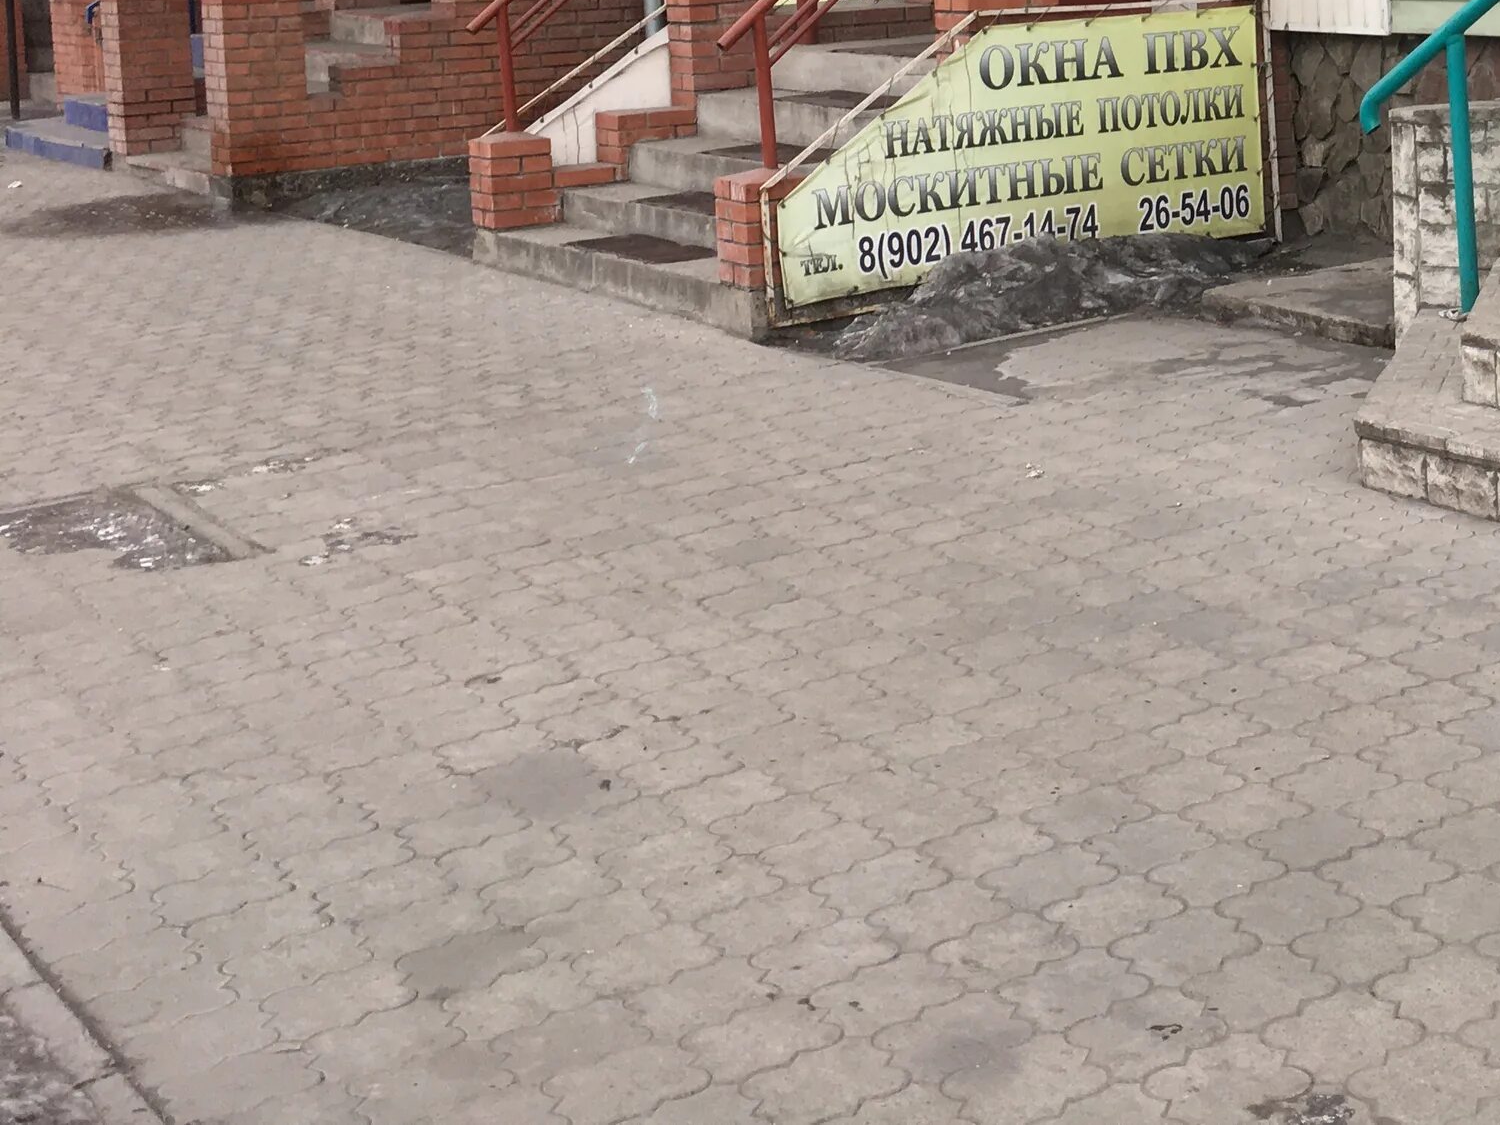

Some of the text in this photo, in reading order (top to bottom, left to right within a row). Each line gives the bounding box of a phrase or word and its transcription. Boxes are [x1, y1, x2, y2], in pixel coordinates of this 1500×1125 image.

[979, 25, 1243, 91] ОКНА ПВХ
[882, 83, 1245, 160] НАТЯЖНЫЕ ПОТОЛКИ
[812, 135, 1248, 230] МОСКИТНЫЕ СЕТКИ
[859, 223, 951, 279] 8(902)
[961, 204, 1099, 253] 467-14-74
[1138, 186, 1250, 234] 26-54-06
